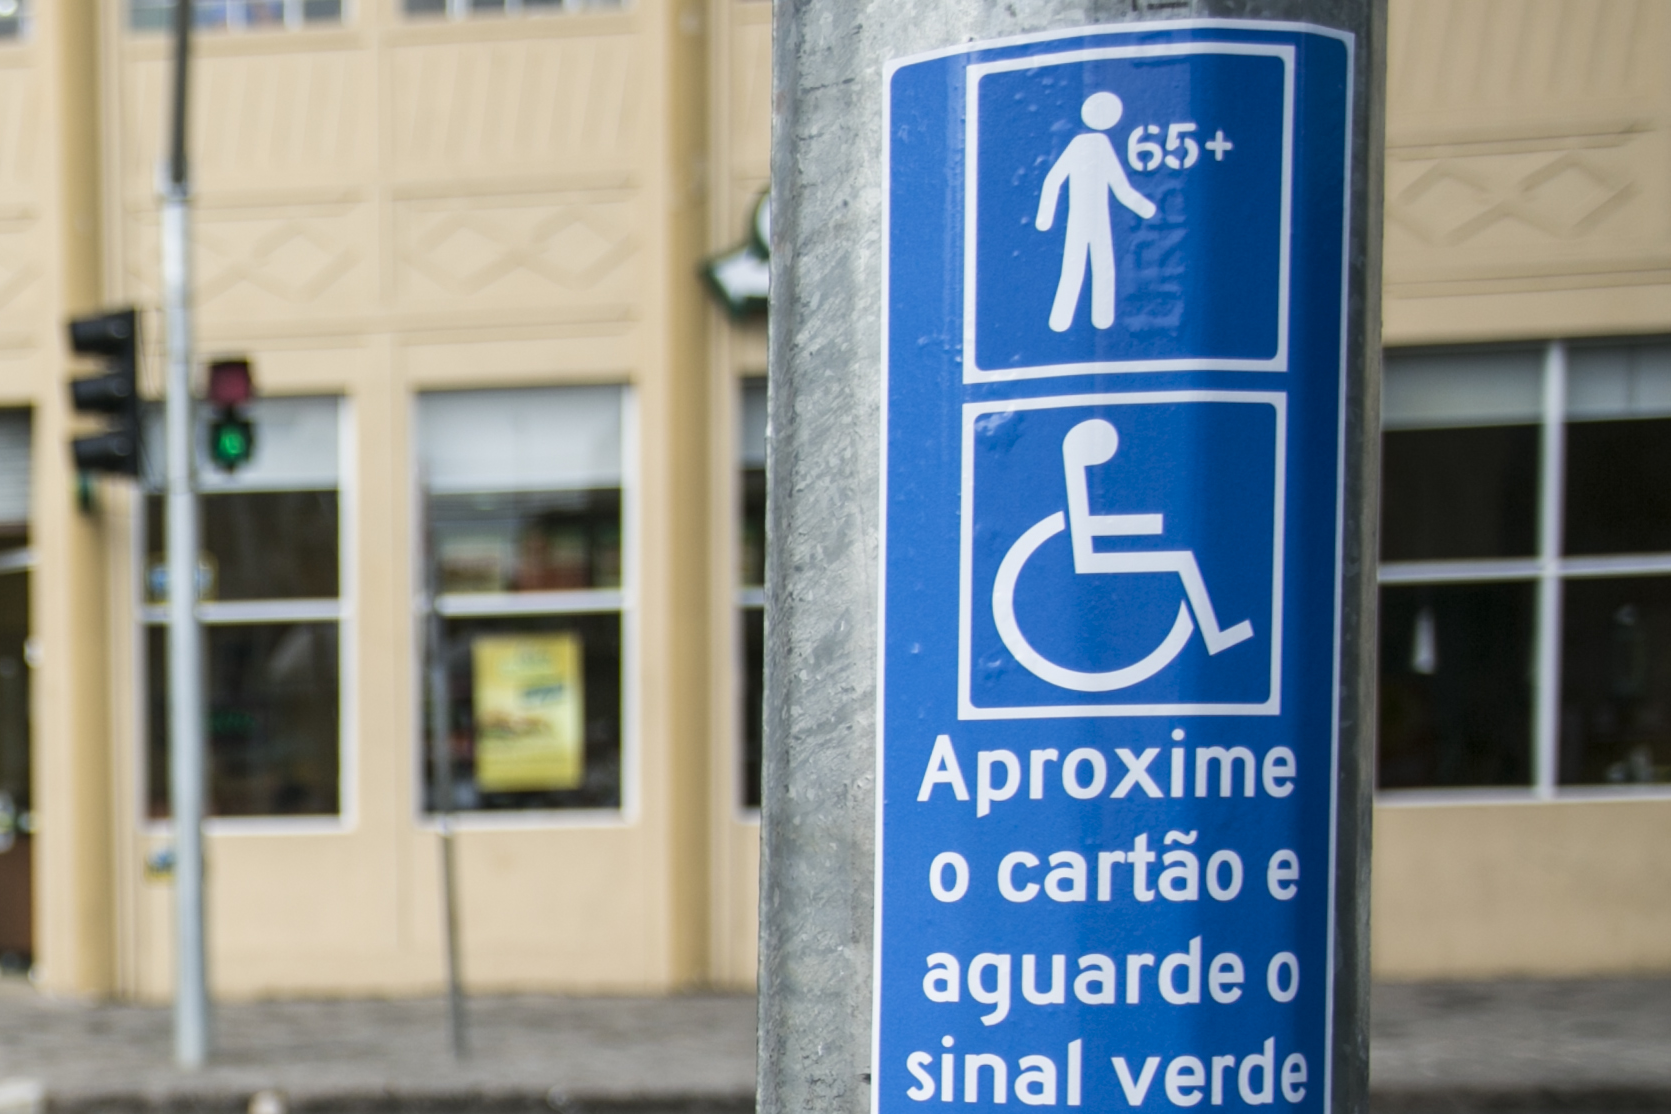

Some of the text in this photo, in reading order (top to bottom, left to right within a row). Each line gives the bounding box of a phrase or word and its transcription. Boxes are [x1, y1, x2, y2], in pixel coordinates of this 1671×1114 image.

[1126, 122, 1234, 172] 65+
[916, 728, 1298, 818] Aproxime
[929, 830, 1301, 904] o cartão e
[921, 935, 1300, 1027] aguarde o
[905, 1034, 1308, 1108] sinal verde
